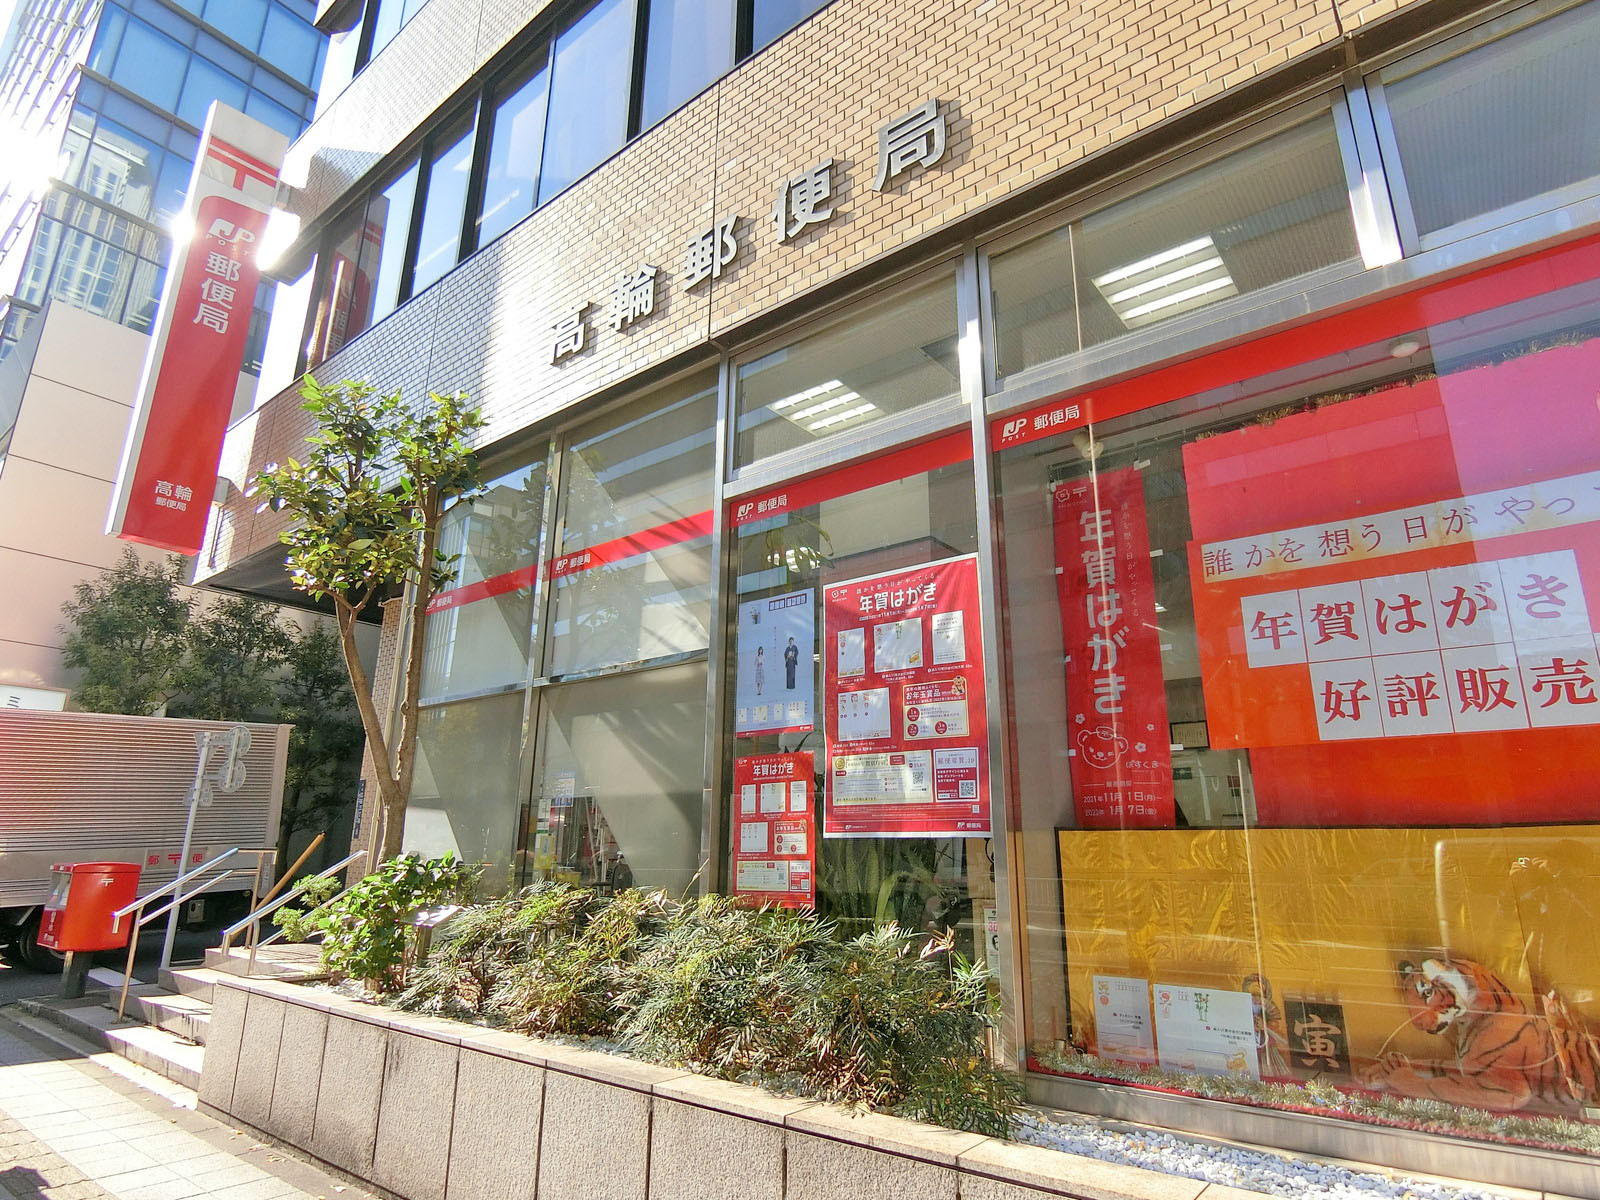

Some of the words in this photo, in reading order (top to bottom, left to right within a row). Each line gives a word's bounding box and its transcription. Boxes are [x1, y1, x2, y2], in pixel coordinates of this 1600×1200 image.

[549, 98, 947, 365] 高輪郵便局
[193, 251, 242, 334] 郵便局
[1034, 404, 1080, 431] 郵便局
[1002, 432, 1026, 443] POST
[154, 480, 194, 502] 高輪
[154, 496, 187, 512] 郵便局
[757, 494, 788, 514] 郵便局
[1203, 485, 1600, 578] 誰かを想う日がやっ
[859, 582, 937, 614] 年賀はがき
[1079, 508, 1131, 715] 年賀はがき
[1249, 573, 1570, 651] 年賀はがき
[906, 688, 941, 701] お年玉賞品
[1319, 657, 1600, 724] 好評販売
[753, 762, 795, 776] 年賀はがき
[1125, 760, 1160, 769] ぽすくま
[1293, 1013, 1342, 1069] 寅
